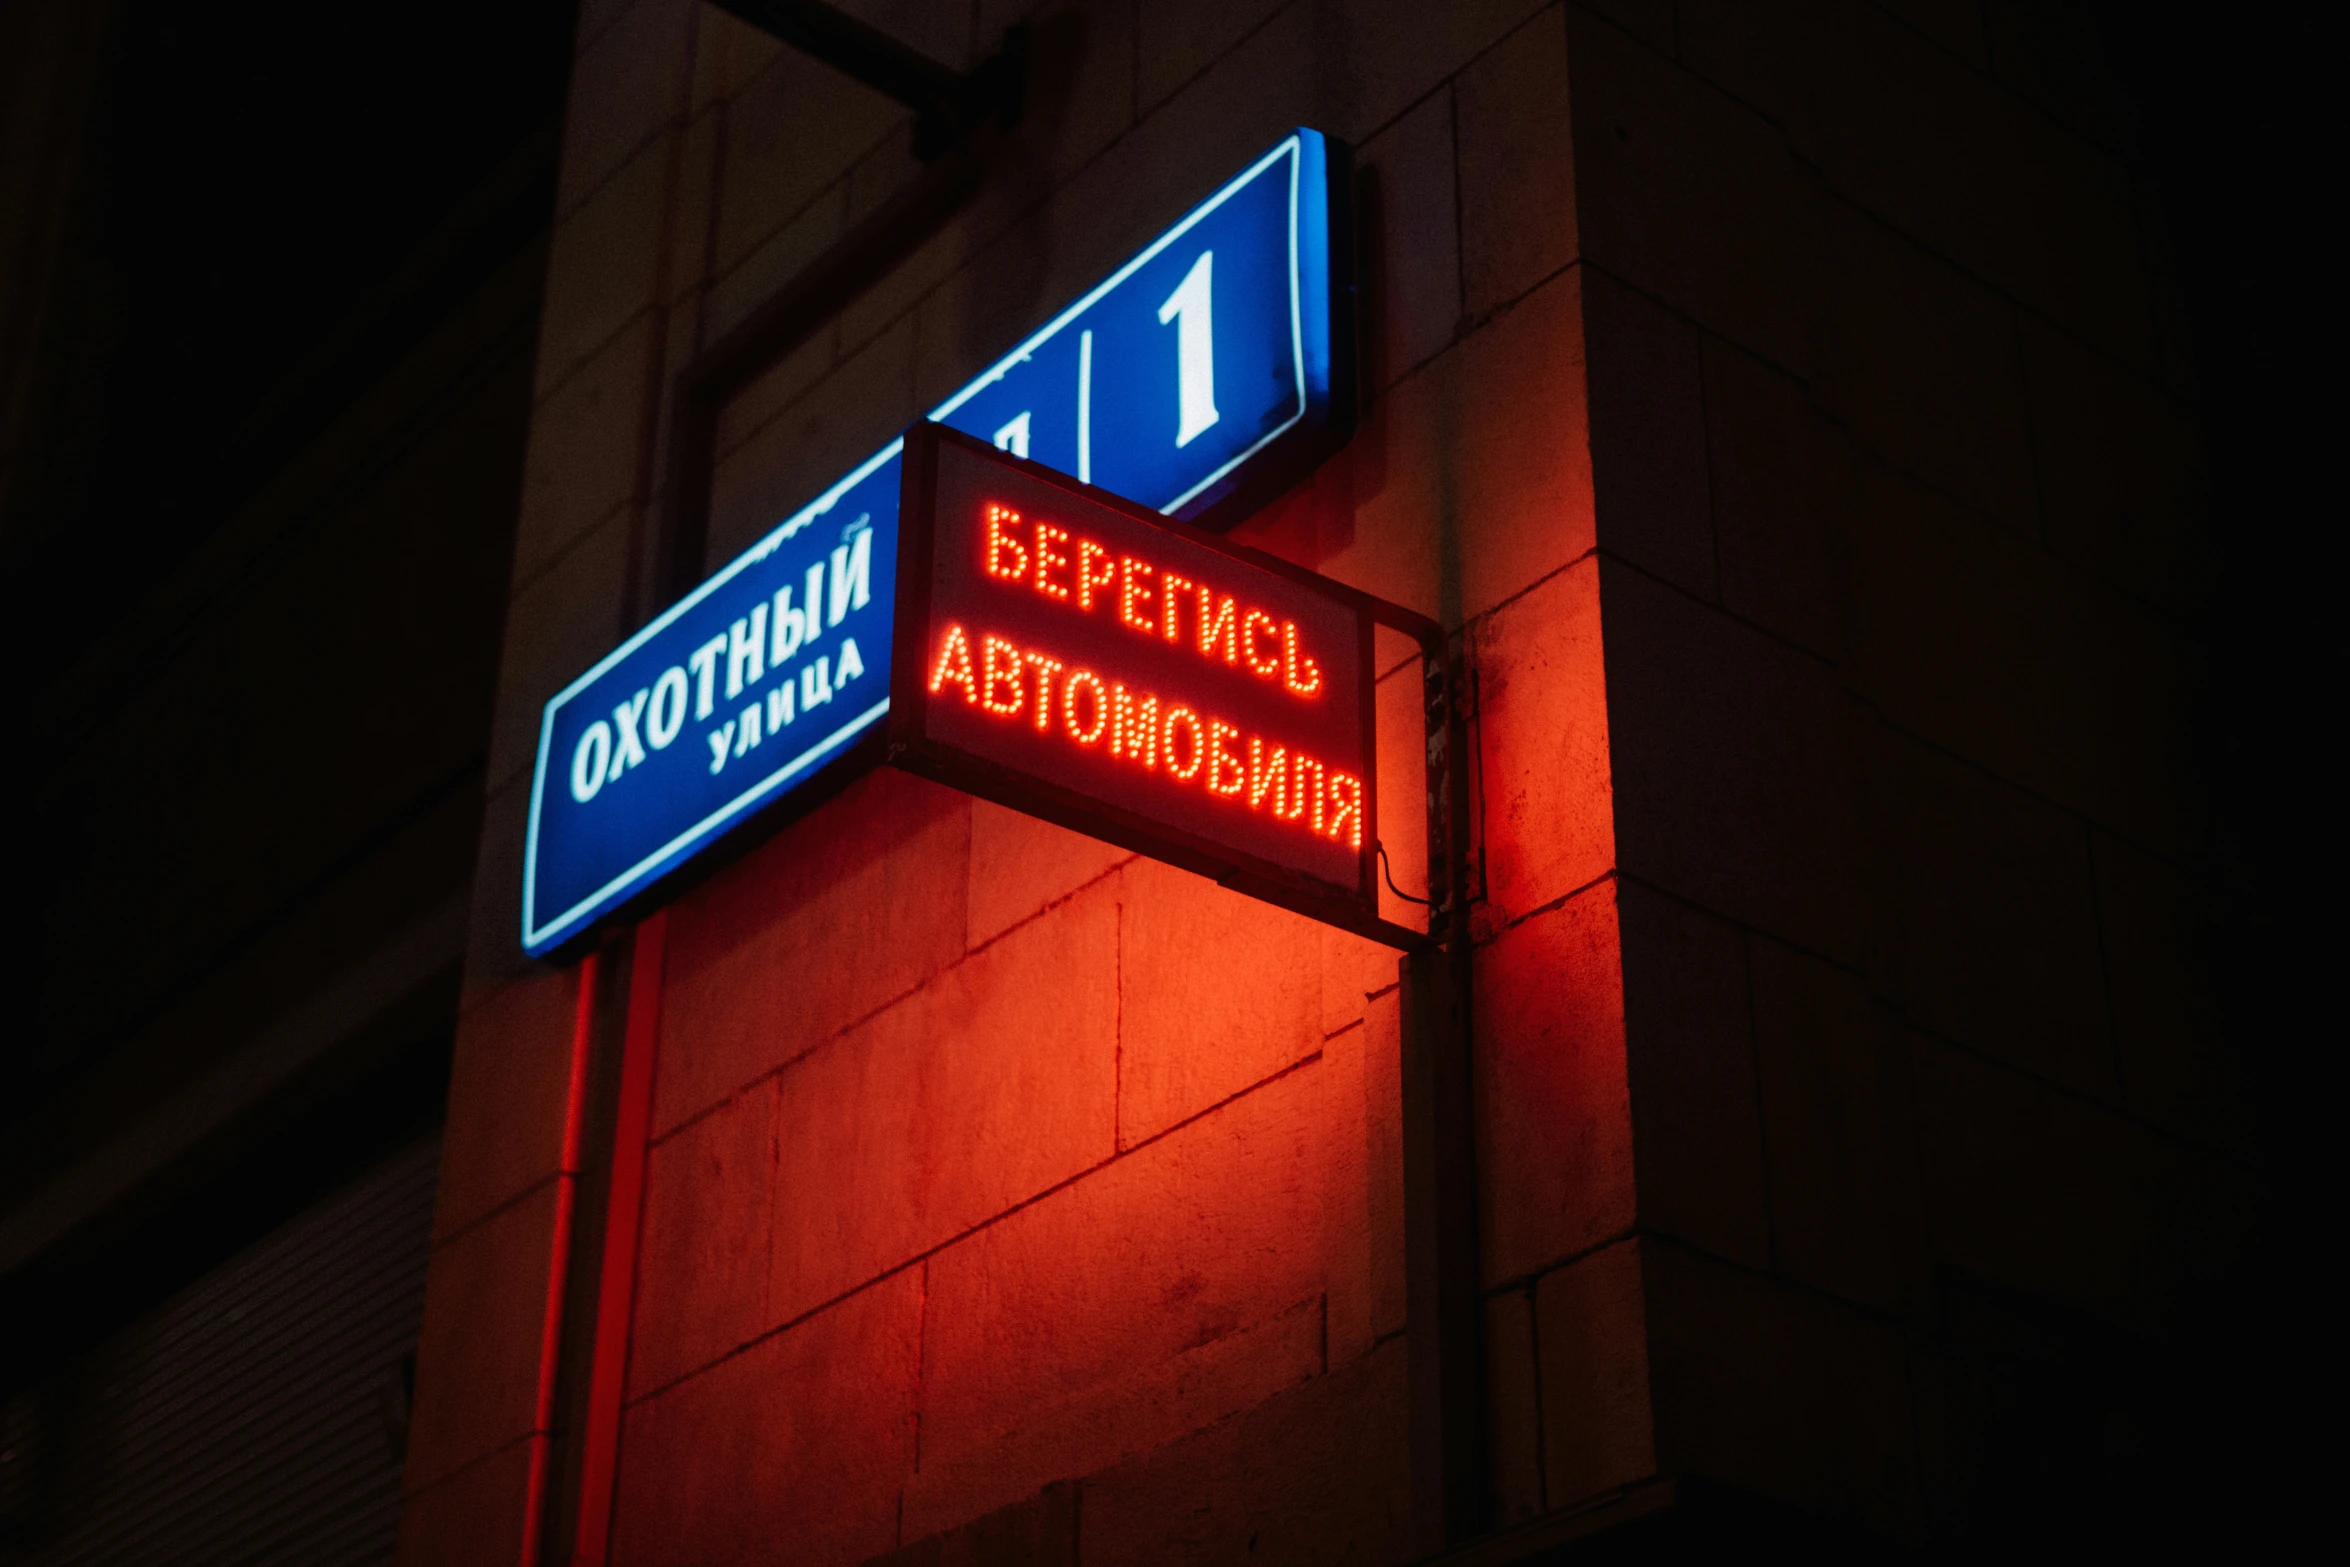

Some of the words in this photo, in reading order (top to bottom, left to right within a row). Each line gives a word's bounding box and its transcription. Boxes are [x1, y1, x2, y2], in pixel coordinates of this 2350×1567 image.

[1158, 249, 1220, 449] 1
[570, 512, 873, 803] ОХОТНЫЙ
[985, 503, 1320, 696] БЕРЕГИСЬ
[707, 637, 864, 775] УЛИЦА
[930, 626, 1363, 849] АВТОМОБИЛЯ
